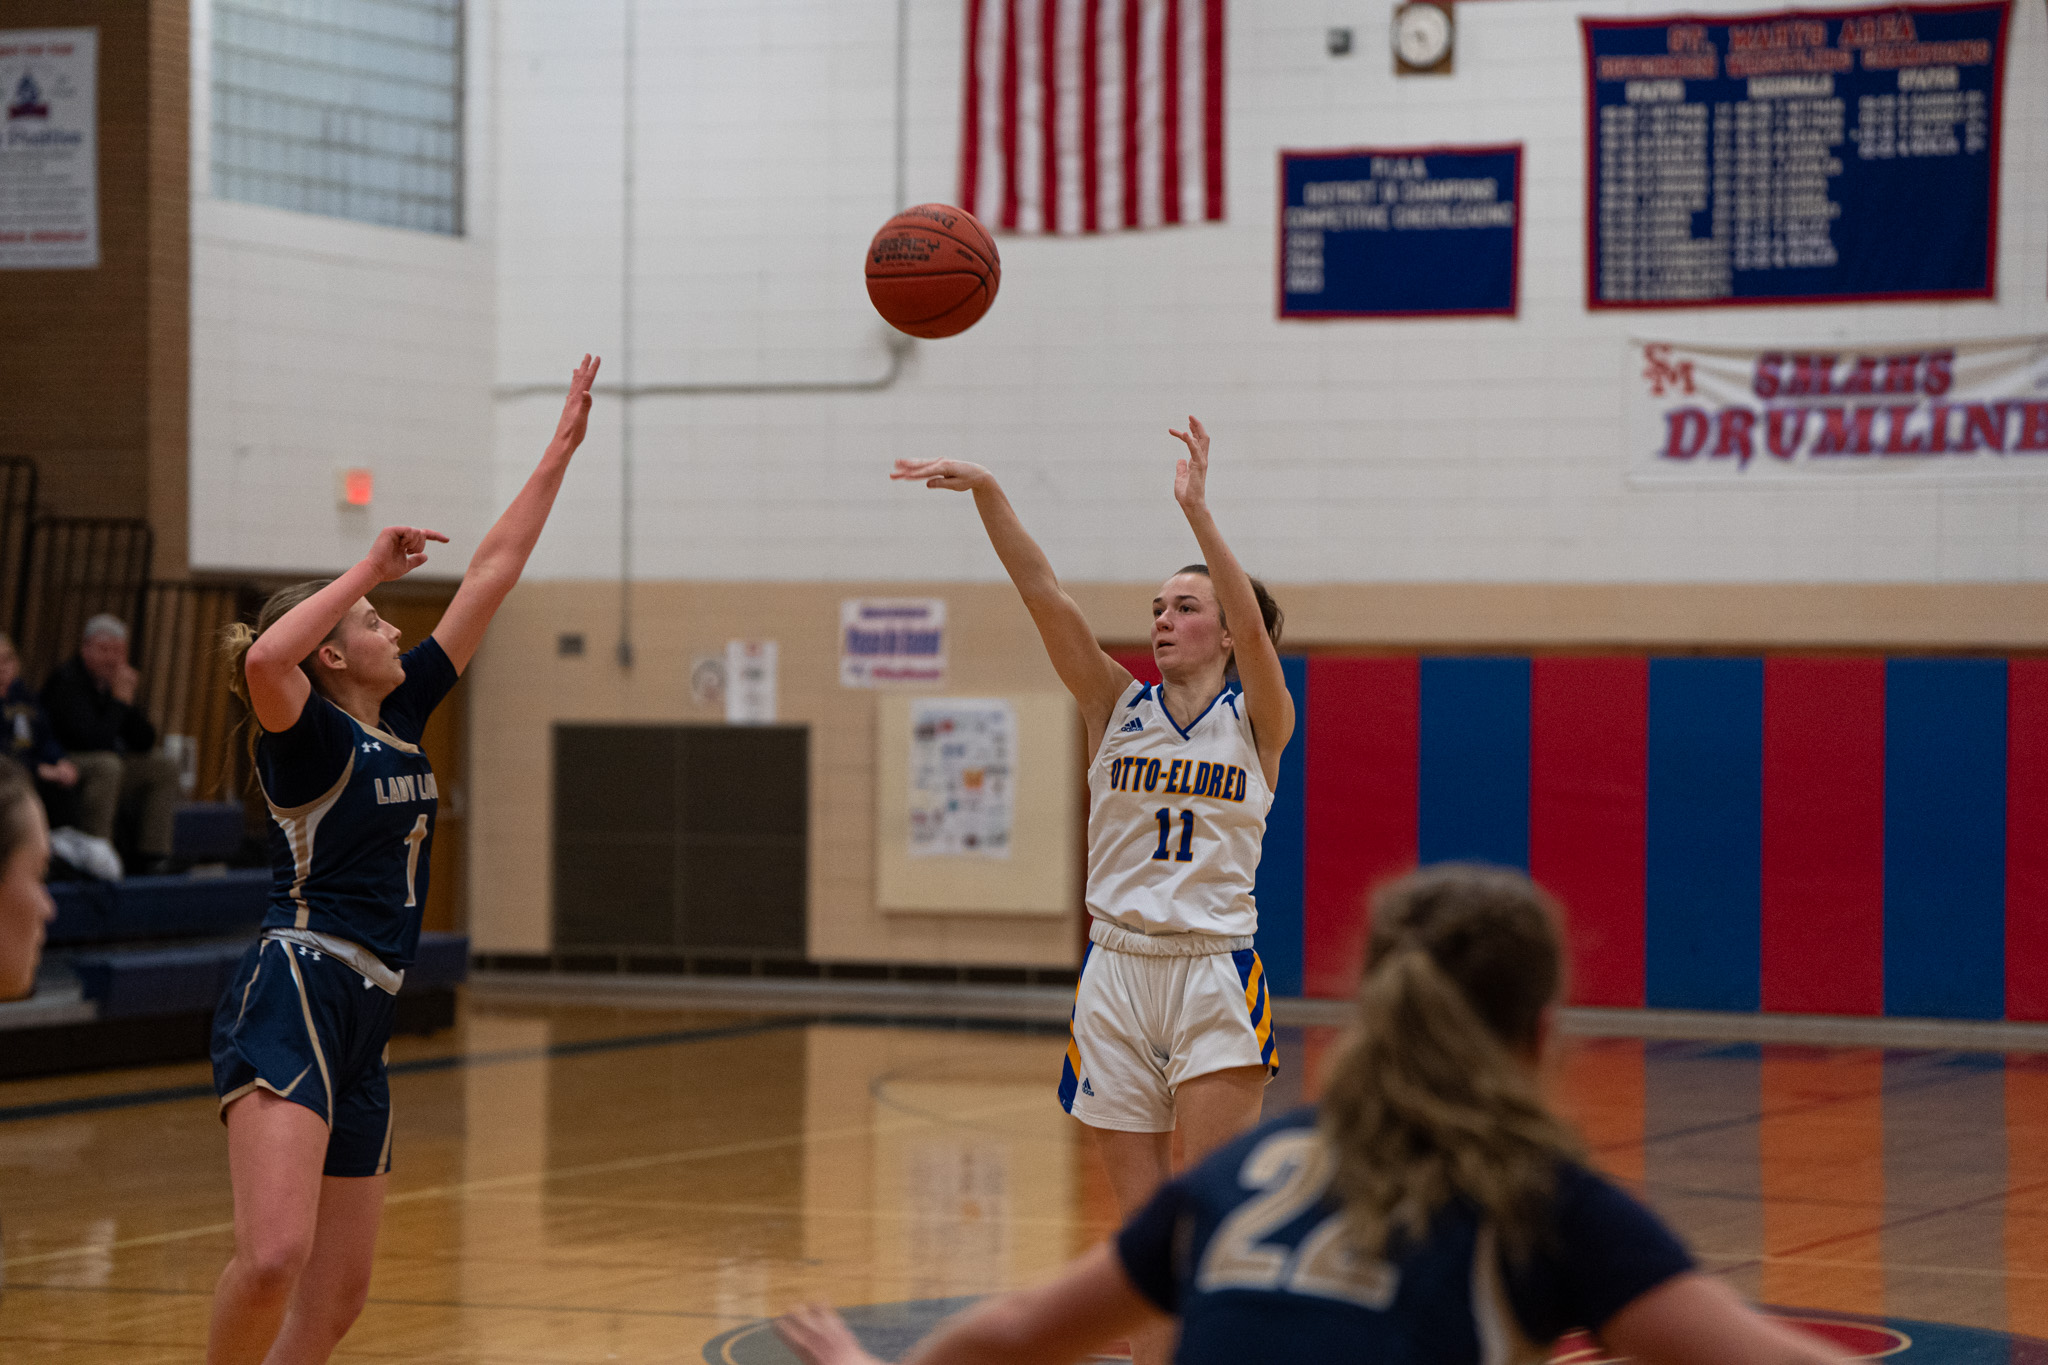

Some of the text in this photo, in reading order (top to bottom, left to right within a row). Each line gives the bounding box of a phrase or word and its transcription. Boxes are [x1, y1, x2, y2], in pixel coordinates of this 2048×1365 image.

[1402, 179, 1497, 202] CHAMPIONS
[1287, 206, 1388, 230] COMPETITIVE
[1754, 348, 1954, 399] SMAHS
[375, 776, 416, 804] LADY
[1110, 756, 1247, 804] OTTO-ELDRED
[1151, 807, 1195, 863] 11
[404, 814, 428, 907] 1
